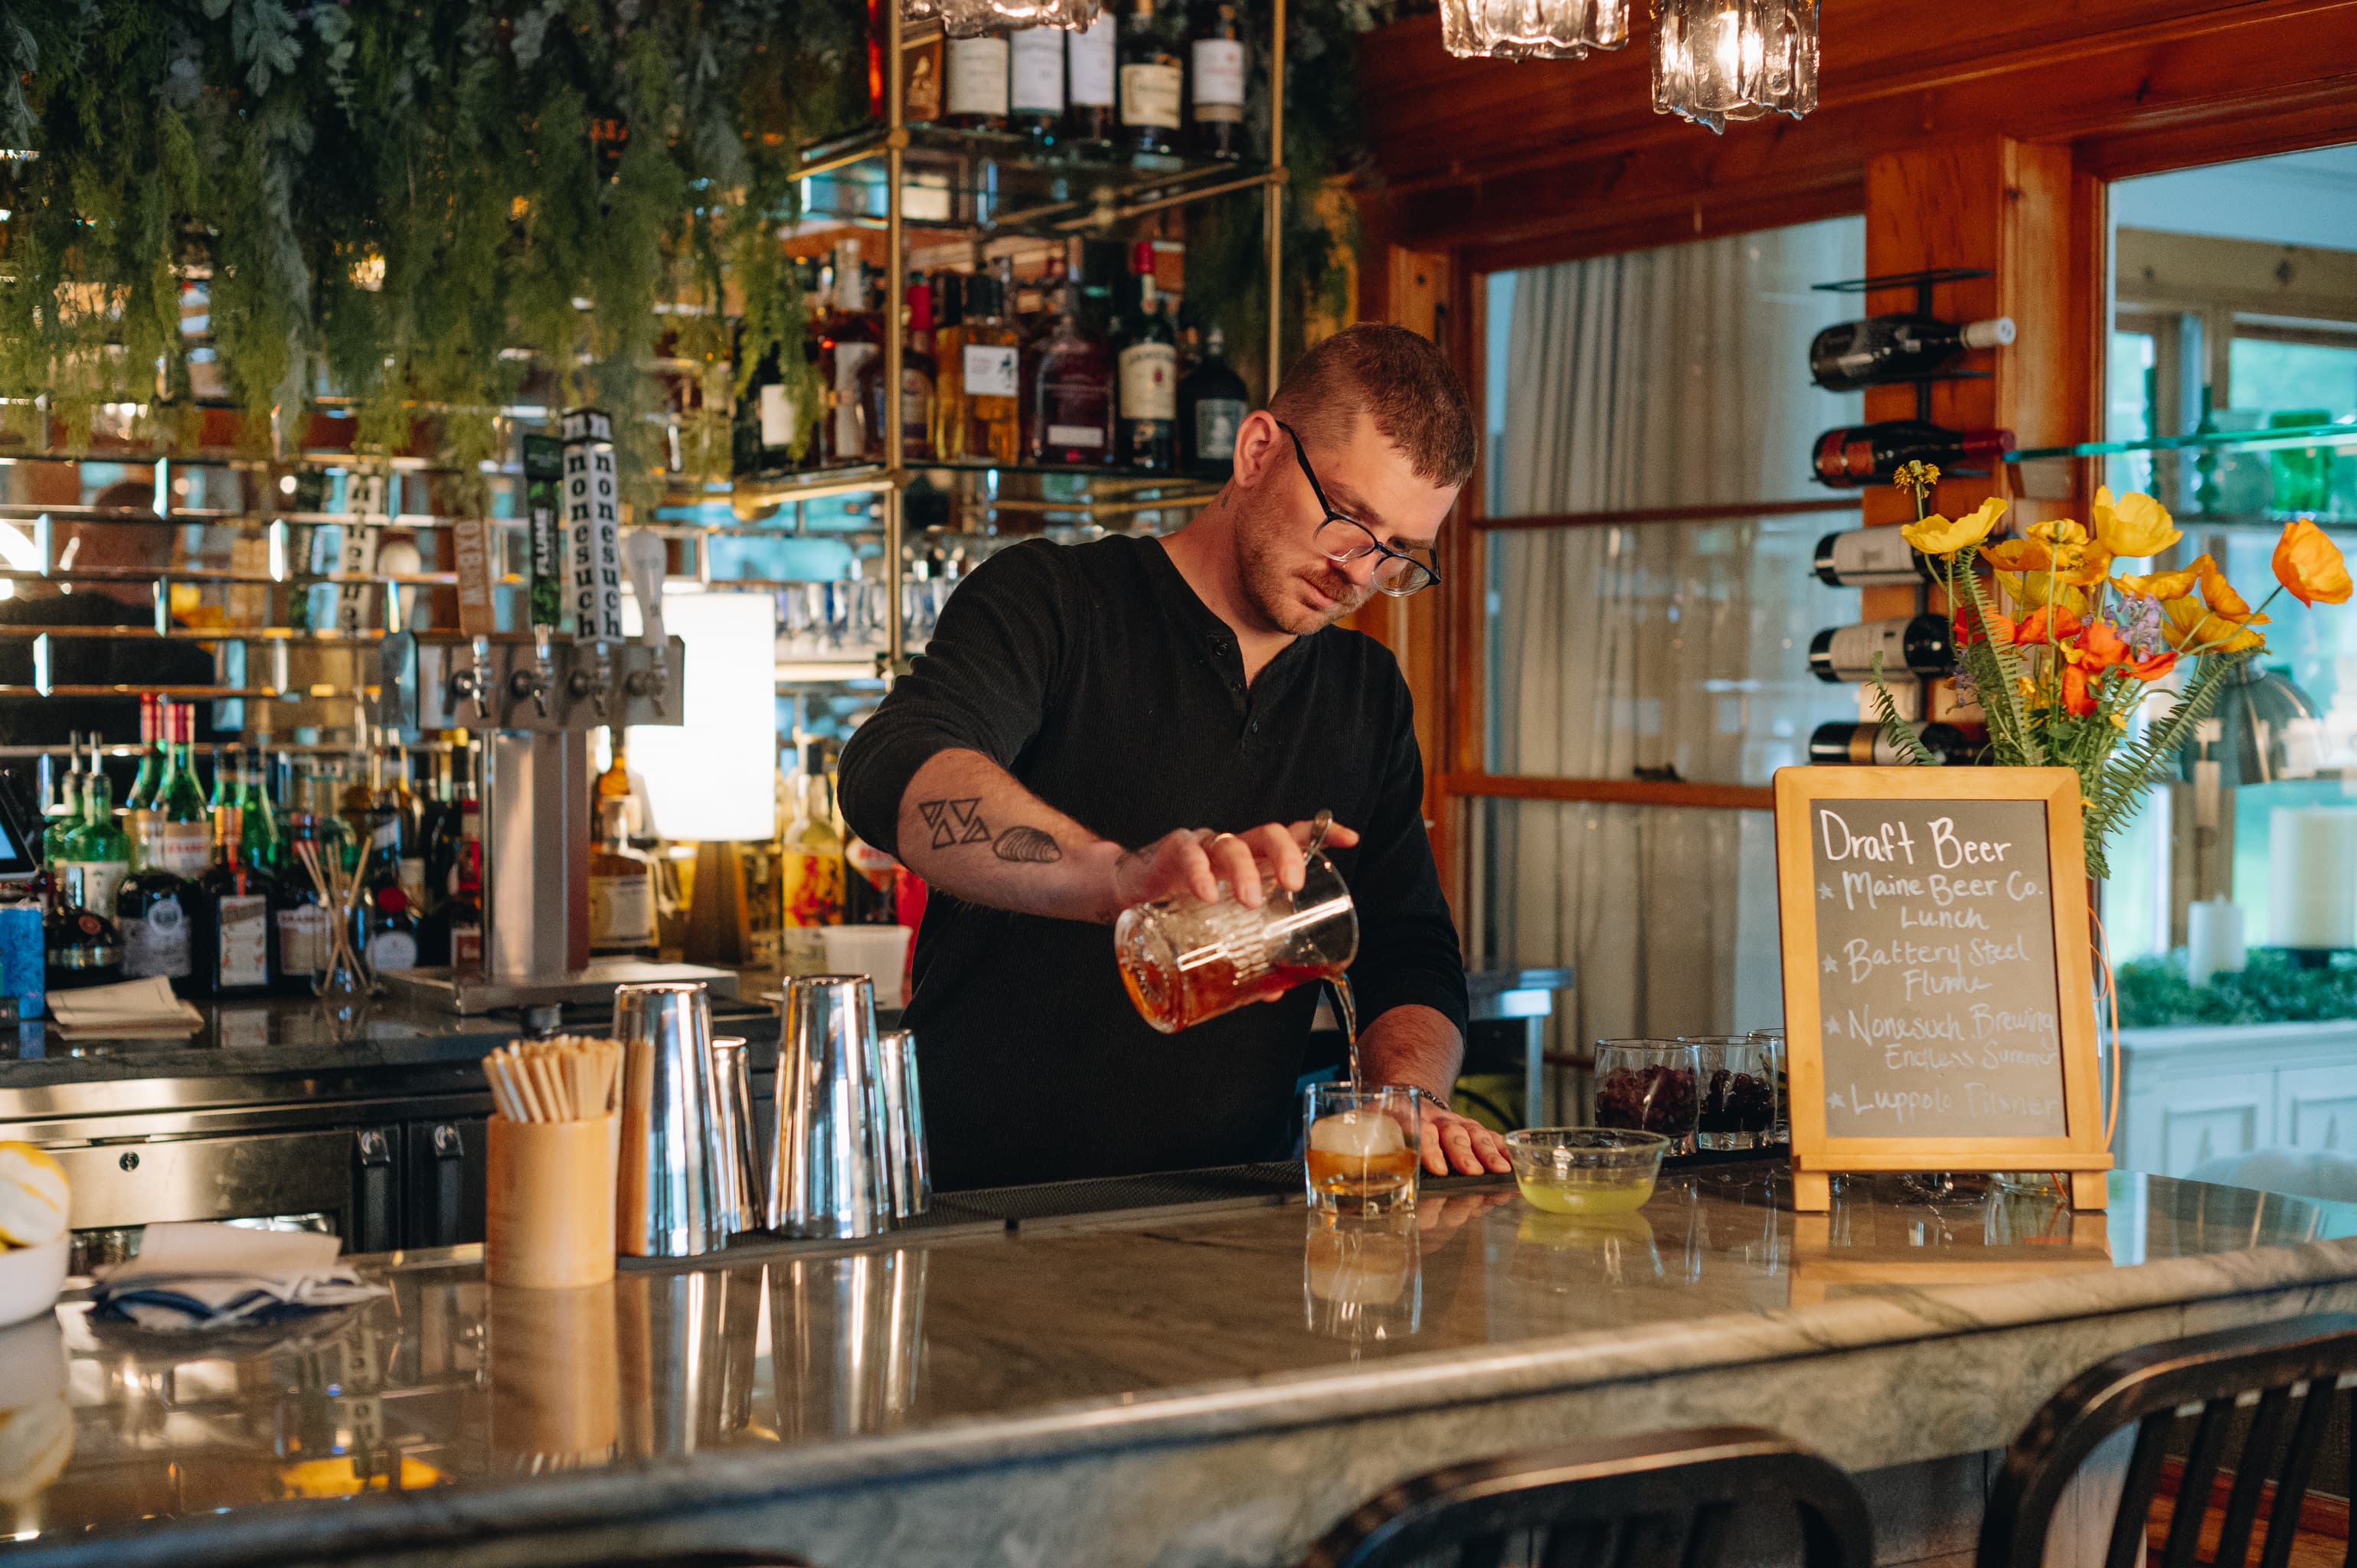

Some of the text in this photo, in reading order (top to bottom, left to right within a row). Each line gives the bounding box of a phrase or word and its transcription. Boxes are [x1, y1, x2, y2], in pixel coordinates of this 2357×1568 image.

[568, 455, 596, 639] nonesuch
[595, 453, 620, 639] nonesuch
[1819, 808, 2012, 869] Draft Beer
[1842, 870, 2045, 911] Maine Beer Co.
[1901, 906, 1990, 929] Lunch
[1843, 933, 2030, 985] Battery Steel
[1902, 969, 1993, 1001] Flume
[1848, 1003, 2058, 1050] Nonesuch Brewing
[1850, 1083, 1953, 1122] Luppolo
